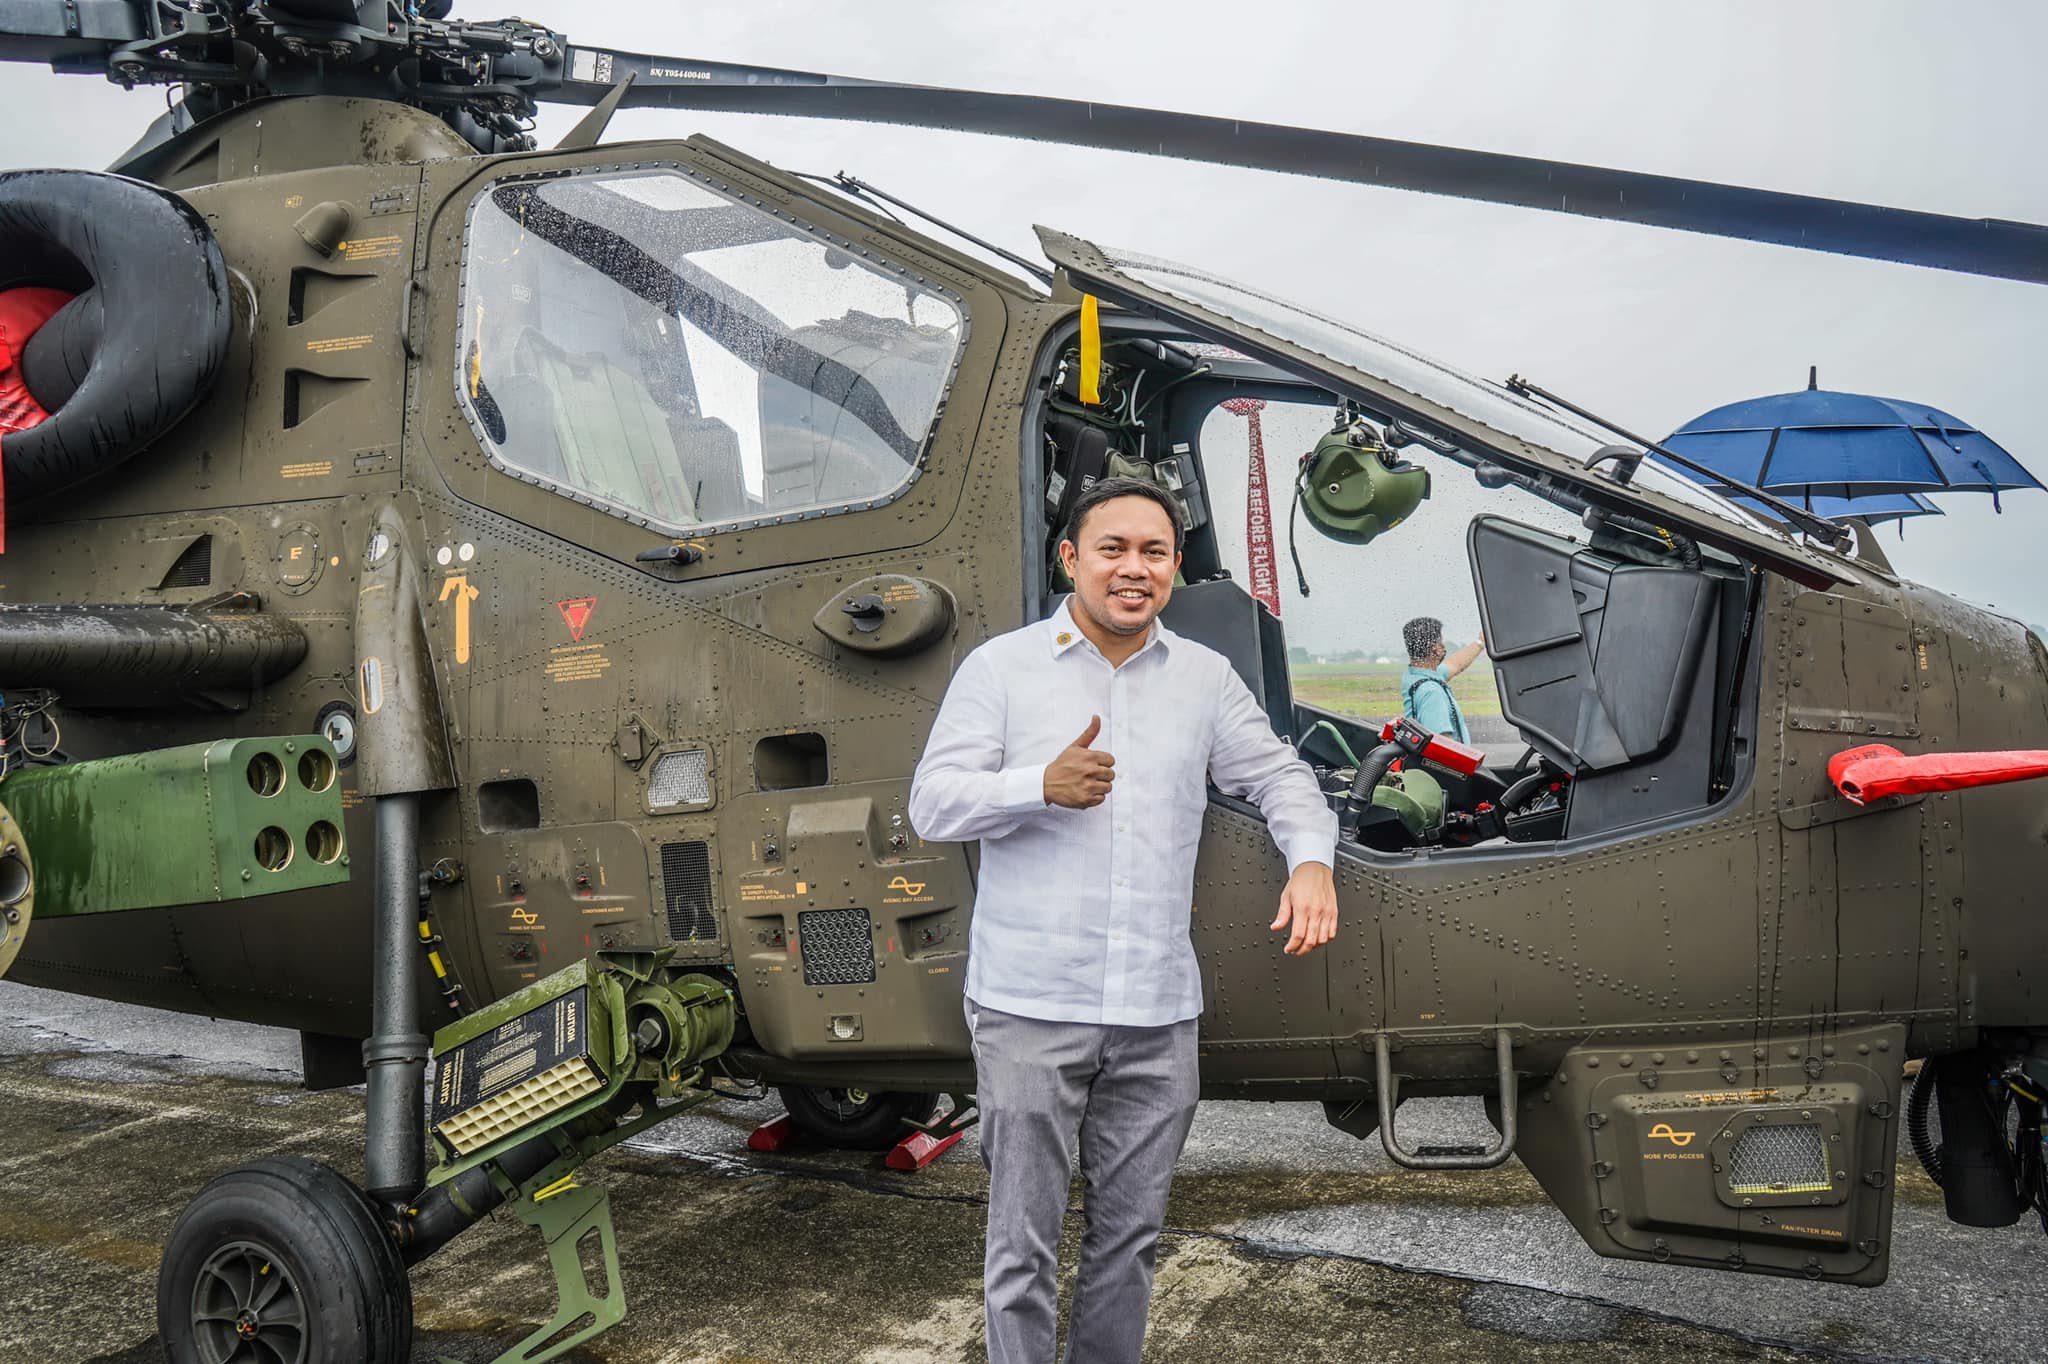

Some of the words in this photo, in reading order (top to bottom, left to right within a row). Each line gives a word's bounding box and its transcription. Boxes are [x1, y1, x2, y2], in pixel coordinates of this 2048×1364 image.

[1250, 488, 1266, 544] BEFORE
[1253, 546, 1273, 596] FLIGHT
[567, 1002, 576, 1043] CAUTION
[440, 1061, 452, 1104] CAUTION
[1643, 1152, 1661, 1160] NOSE
[1663, 1152, 1677, 1160] POD
[1679, 1152, 1705, 1160] ACCESS
